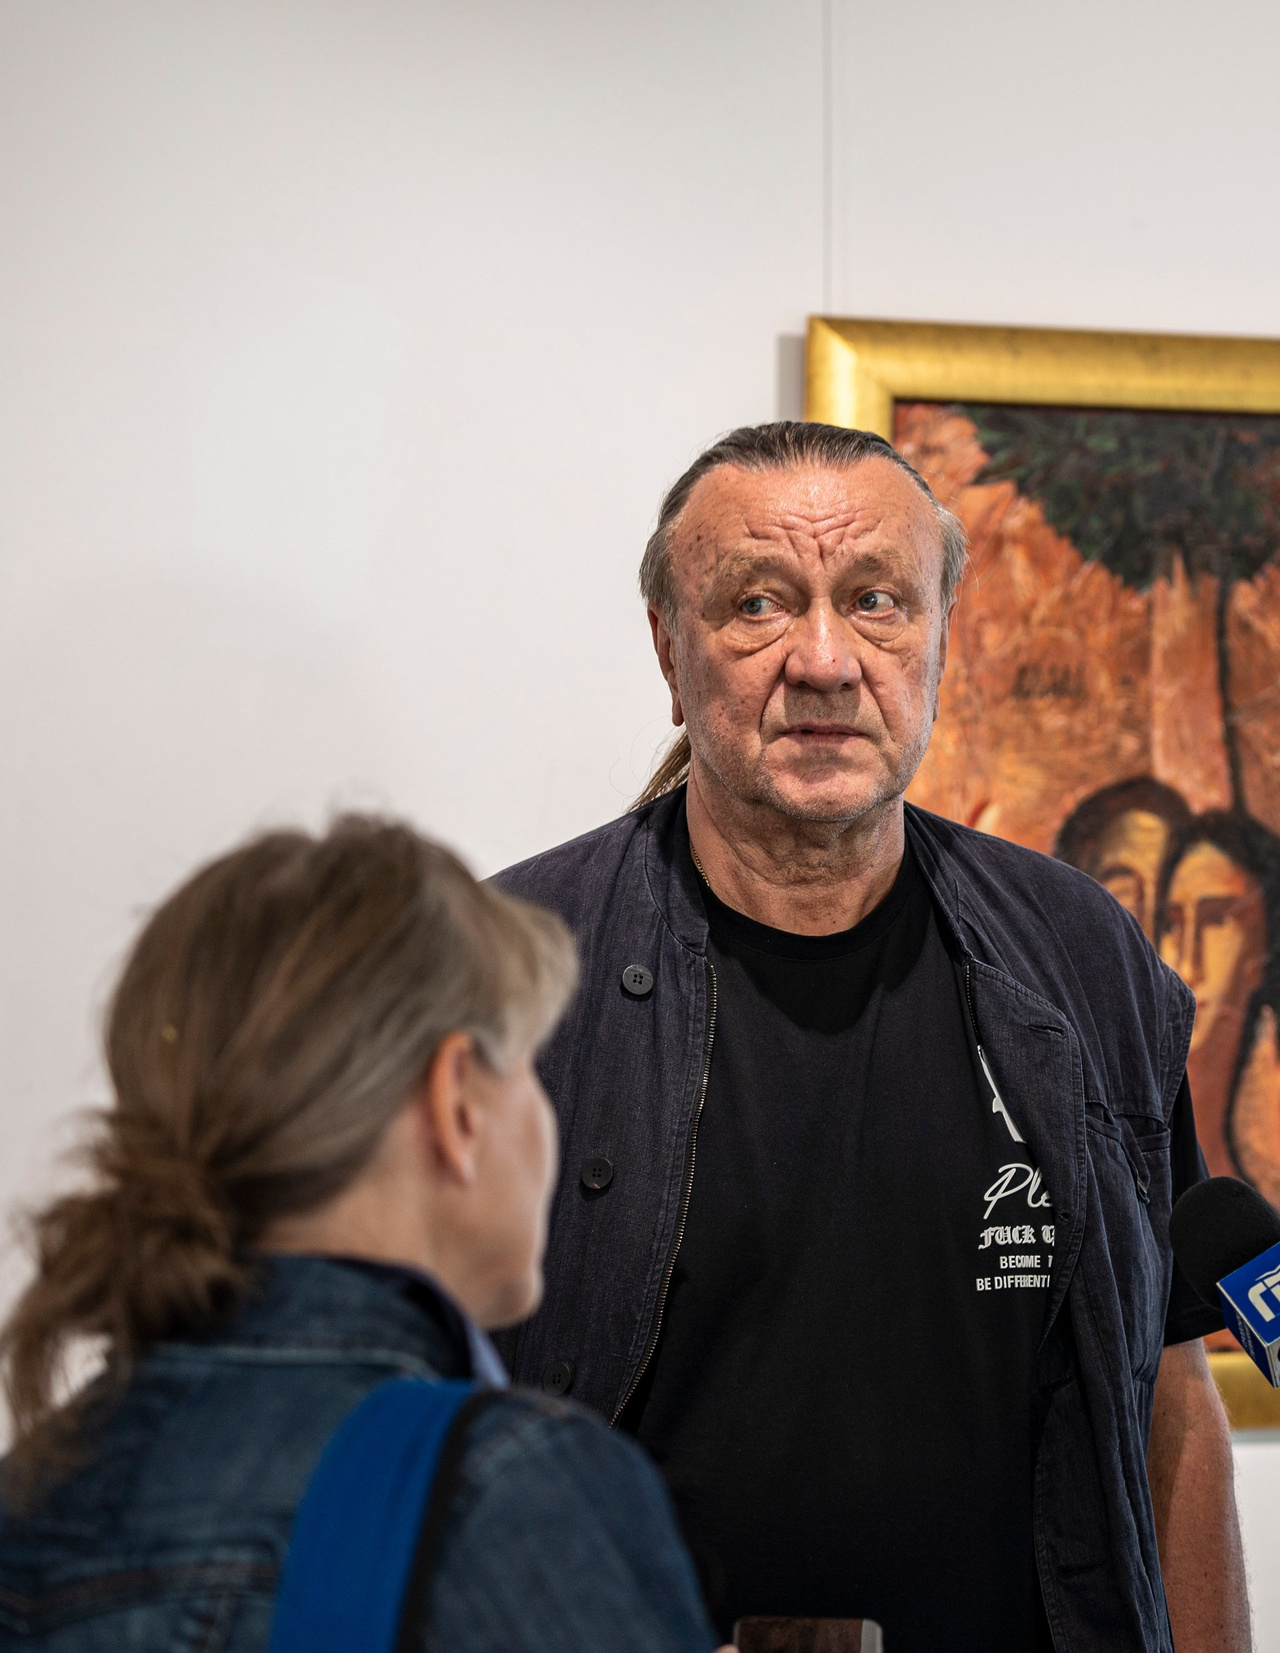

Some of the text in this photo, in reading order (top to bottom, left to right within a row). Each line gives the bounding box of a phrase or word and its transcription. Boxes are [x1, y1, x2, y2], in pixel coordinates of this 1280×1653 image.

[977, 1225, 1036, 1250] FUCK
[999, 1255, 1041, 1269] BECOME
[975, 1278, 992, 1292] BE
